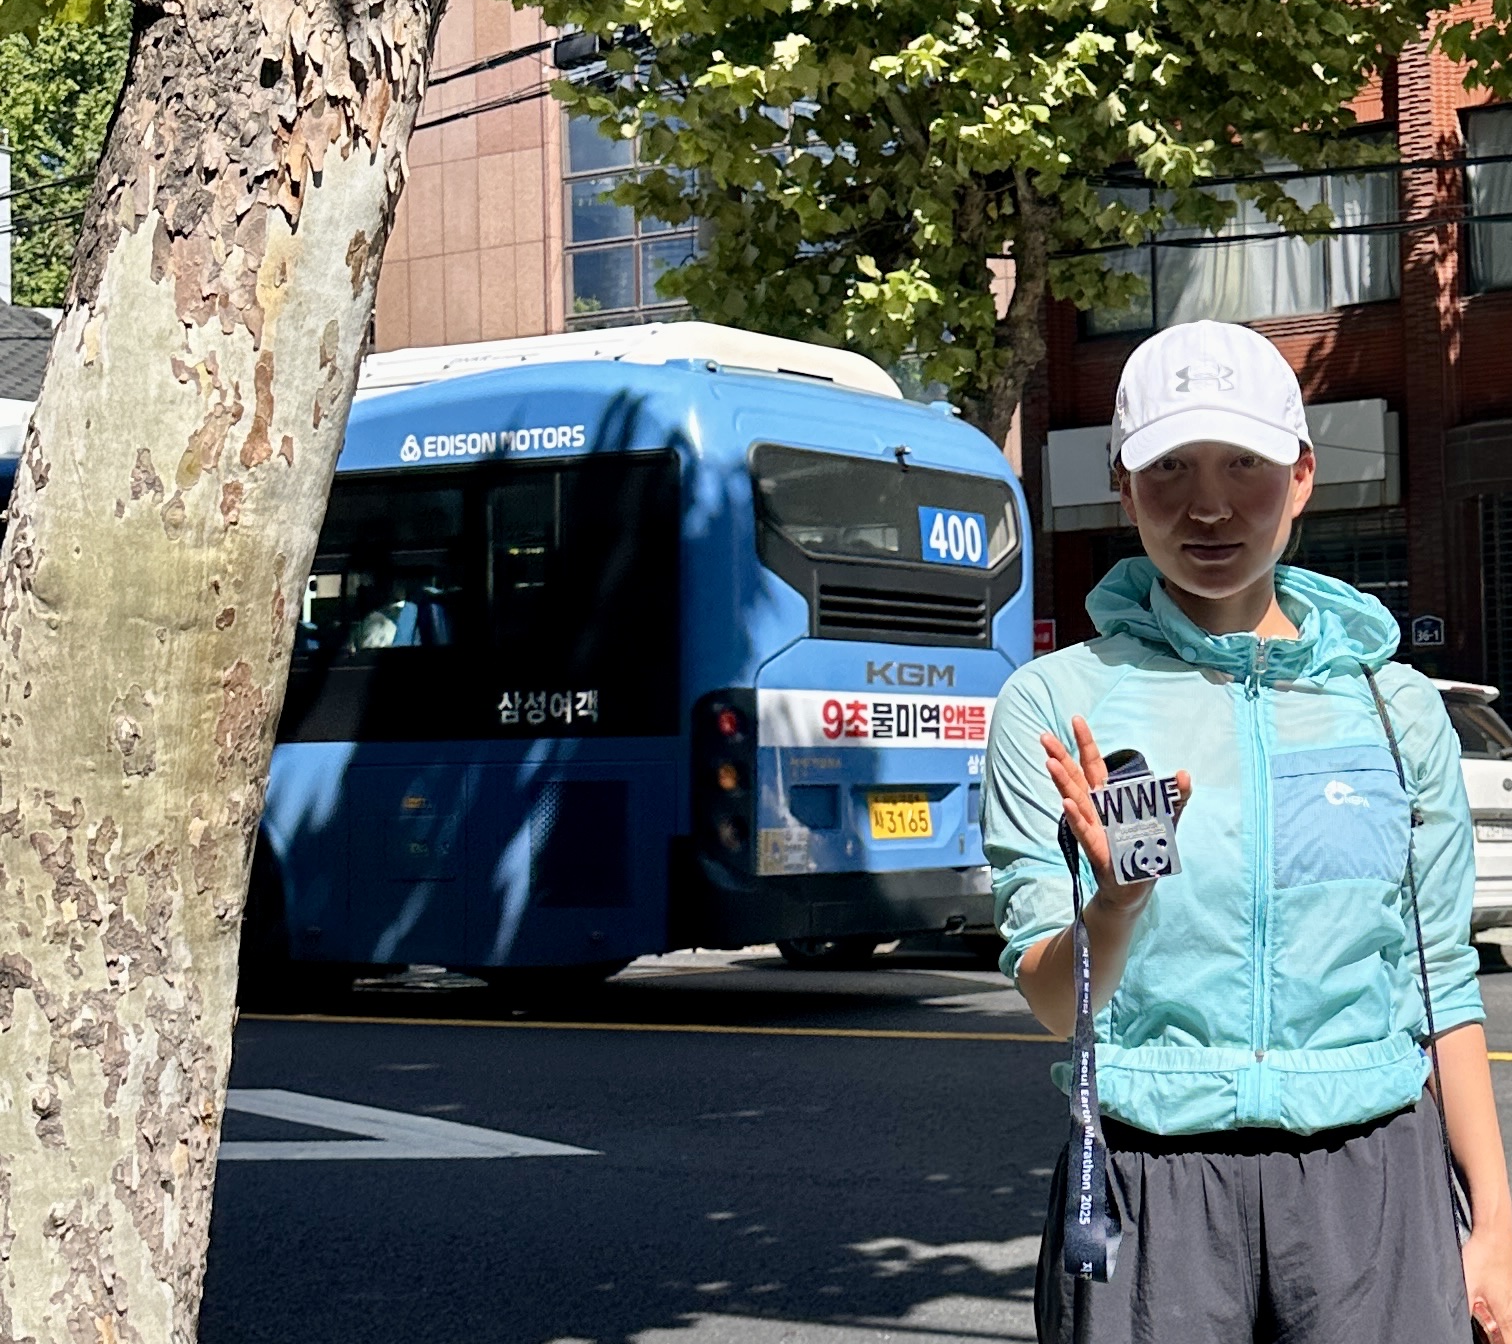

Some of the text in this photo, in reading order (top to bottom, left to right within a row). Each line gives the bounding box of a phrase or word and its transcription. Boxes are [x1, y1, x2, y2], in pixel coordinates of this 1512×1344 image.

[424, 425, 585, 457] EDISON MOTORS
[930, 513, 982, 562] 400
[1416, 630, 1440, 642] 36-1
[866, 661, 955, 687] KGM
[498, 690, 599, 724] 삼성여객
[1090, 776, 1180, 827] WWF
[1078, 1051, 1096, 1226] Seoul Earth Marathon 2025
